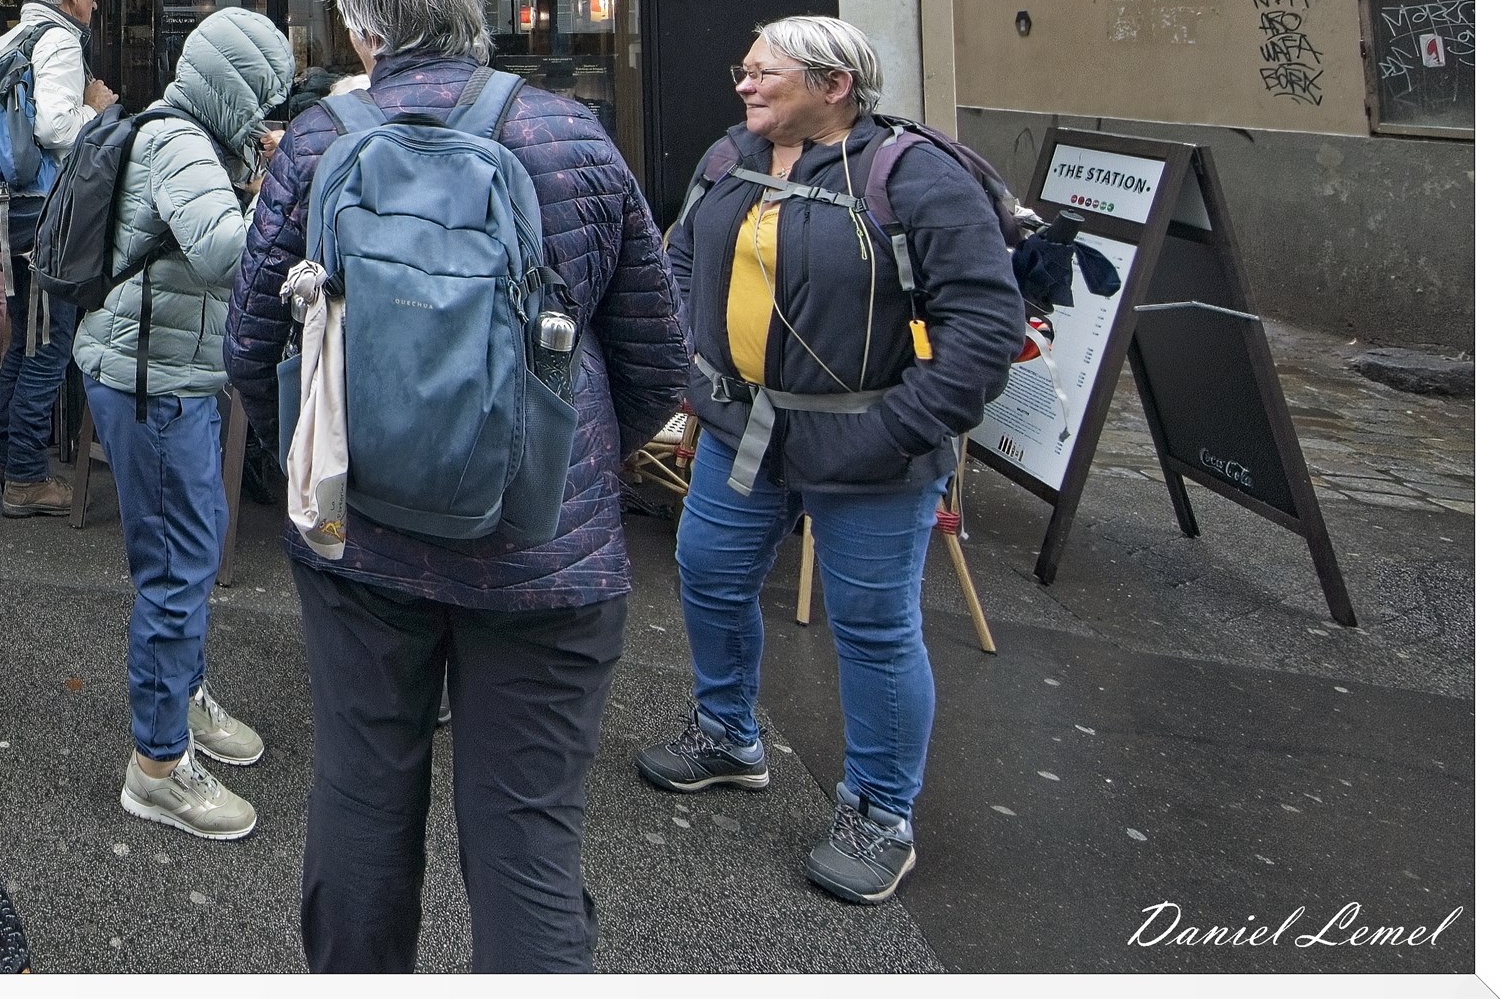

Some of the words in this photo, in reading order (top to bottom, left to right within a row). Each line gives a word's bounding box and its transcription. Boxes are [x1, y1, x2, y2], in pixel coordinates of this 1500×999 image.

[1058, 163, 1084, 179] THE
[1086, 166, 1147, 194] STATION
[395, 298, 434, 310] QUECHUA
